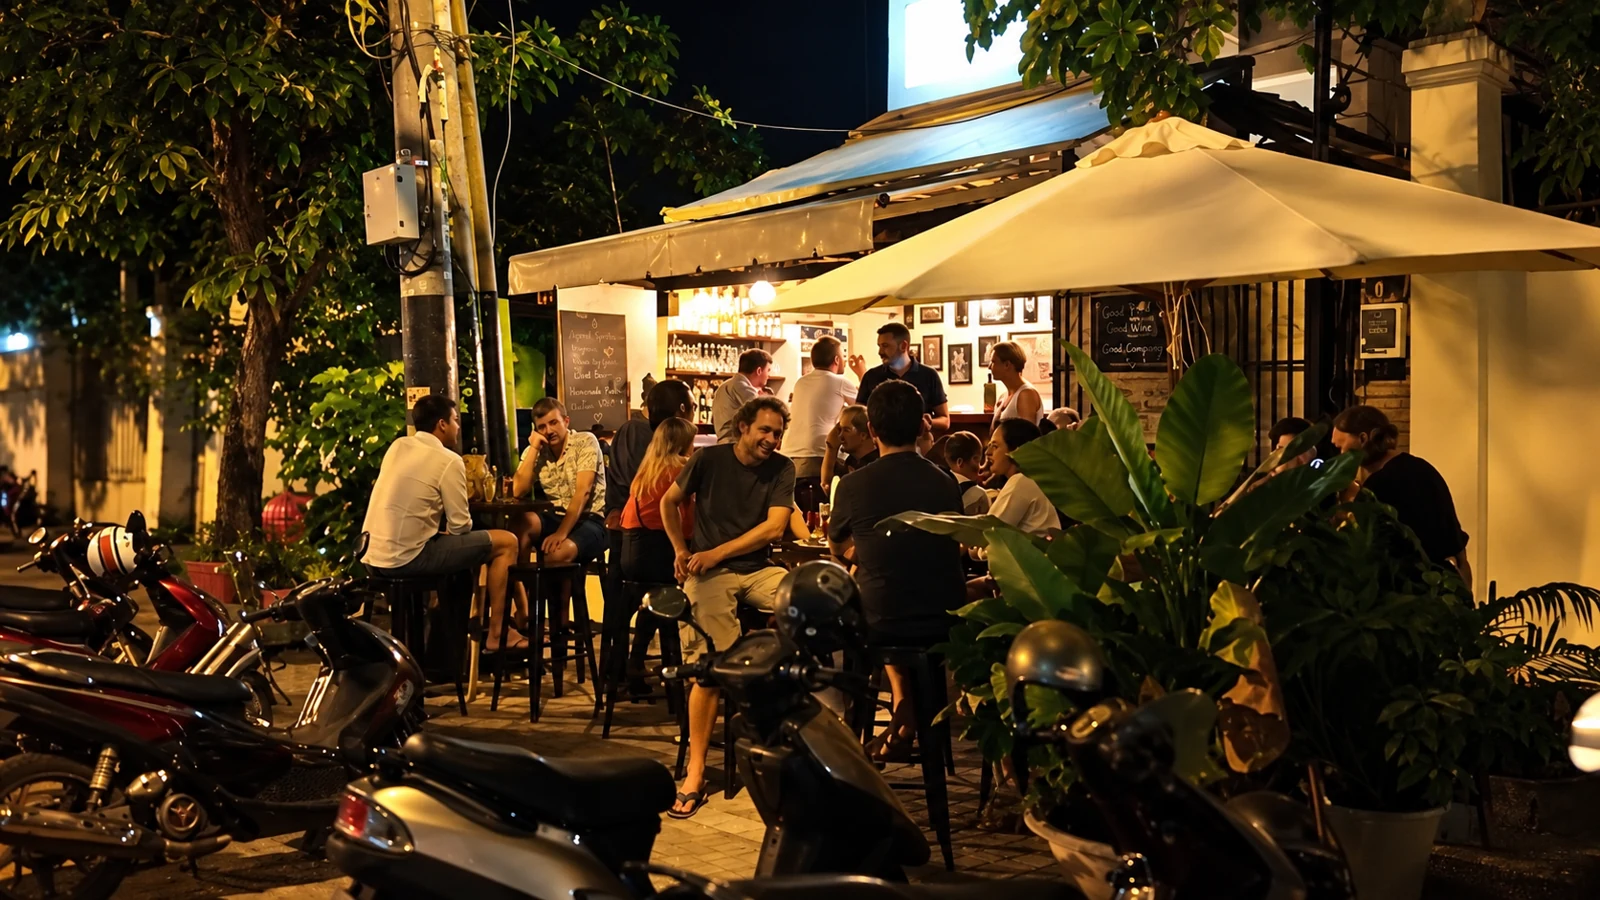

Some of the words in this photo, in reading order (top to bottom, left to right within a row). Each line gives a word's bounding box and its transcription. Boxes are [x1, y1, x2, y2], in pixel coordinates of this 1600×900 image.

[1102, 305, 1124, 319] Good
[1106, 322, 1128, 334] Good
[1130, 322, 1152, 332] Wine
[1102, 343, 1123, 354] Good
[1126, 342, 1163, 360] Company
